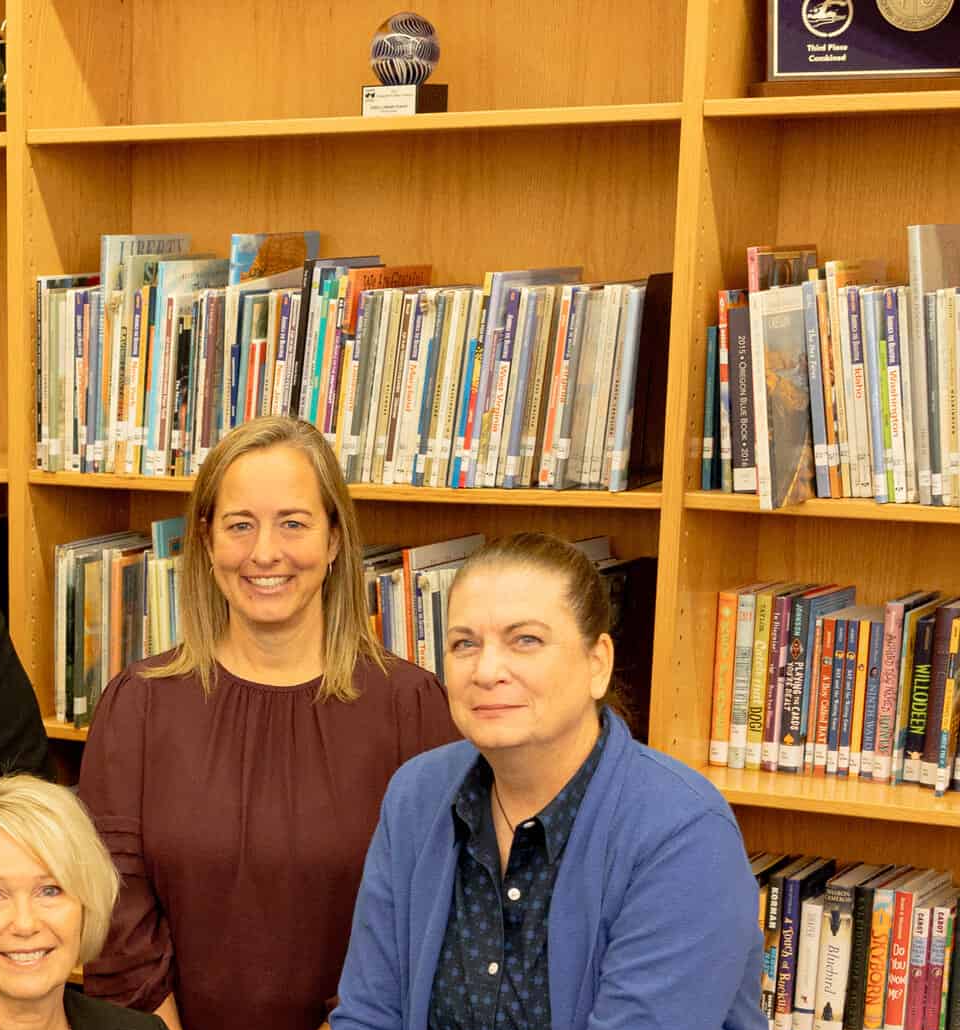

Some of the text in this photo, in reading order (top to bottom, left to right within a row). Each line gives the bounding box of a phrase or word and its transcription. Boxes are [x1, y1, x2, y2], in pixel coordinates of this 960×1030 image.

[806, 43, 849, 52] Third Place
[808, 53, 848, 62] Combined
[738, 335, 746, 354] 2015
[738, 361, 748, 397] OREGON
[853, 367, 864, 400] Idaho
[492, 364, 508, 433] West Virginia
[739, 397, 748, 417] BLUE
[888, 369, 899, 439] Washington
[740, 418, 749, 441] BOOK
[793, 603, 804, 637] JOHNSON
[783, 661, 795, 712] YOU'RE DEALT
[792, 661, 805, 695] PLAYING
[820, 682, 830, 699] Boy
[819, 699, 830, 724] Called
[909, 663, 932, 736] WILLODEEN
[749, 706, 762, 733] DOG!
[790, 706, 802, 731] CARDS
[864, 683, 878, 751] NINTH WARD
[817, 724, 828, 744] BAT
[768, 887, 780, 929] KORMAN
[916, 912, 925, 935] CABOT
[936, 911, 945, 935] CABOT
[893, 943, 905, 957] Do
[823, 944, 841, 996] Bluebird
[865, 928, 888, 1006] SKYBORN
